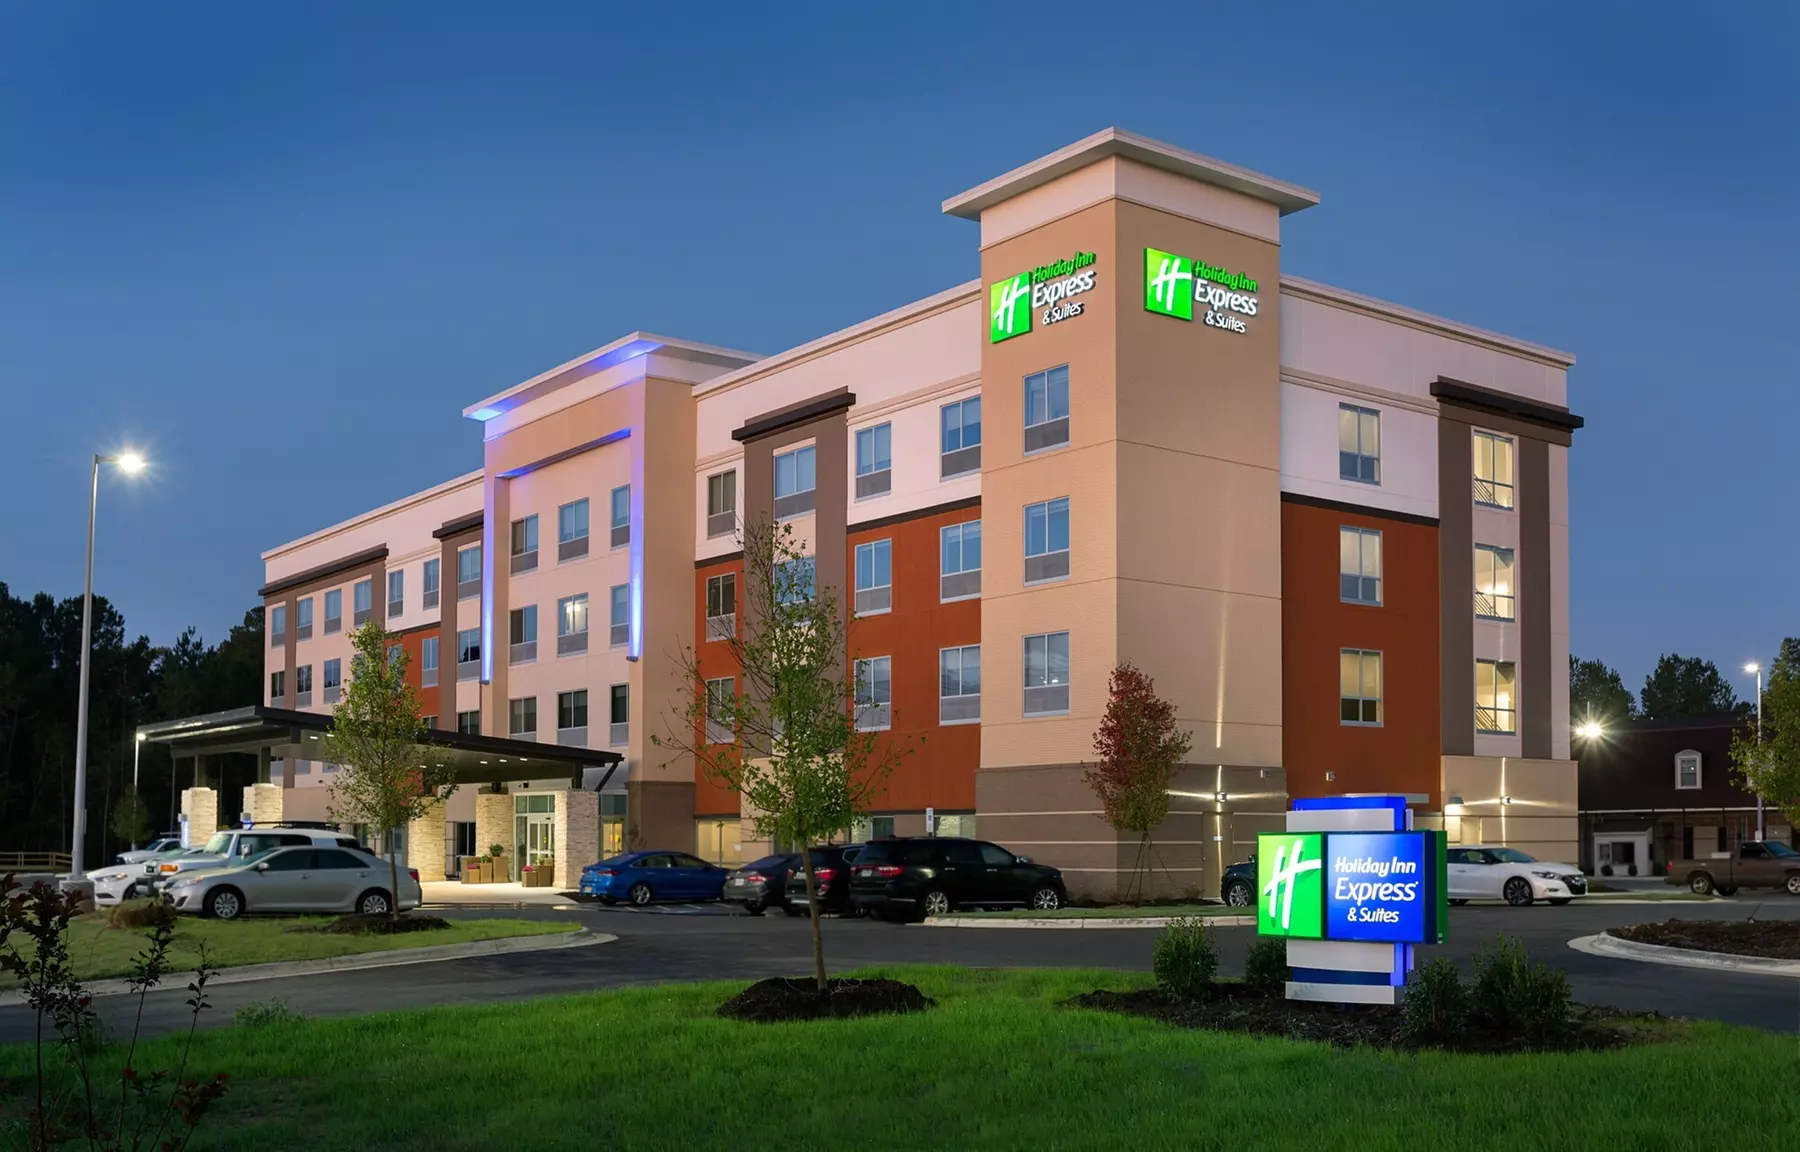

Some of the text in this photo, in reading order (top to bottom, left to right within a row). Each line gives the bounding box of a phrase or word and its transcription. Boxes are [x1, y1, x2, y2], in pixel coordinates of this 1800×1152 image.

[1032, 251, 1095, 283] Holiday Inn
[1195, 260, 1257, 292] Holiday Inn
[1032, 270, 1094, 308] Express
[1195, 278, 1257, 316] Express
[1042, 302, 1083, 325] & Suites
[1205, 310, 1246, 333] & Suites
[1334, 856, 1416, 877] Holiday Inn
[1335, 876, 1416, 906] Express
[1347, 907, 1399, 923] & Suites
